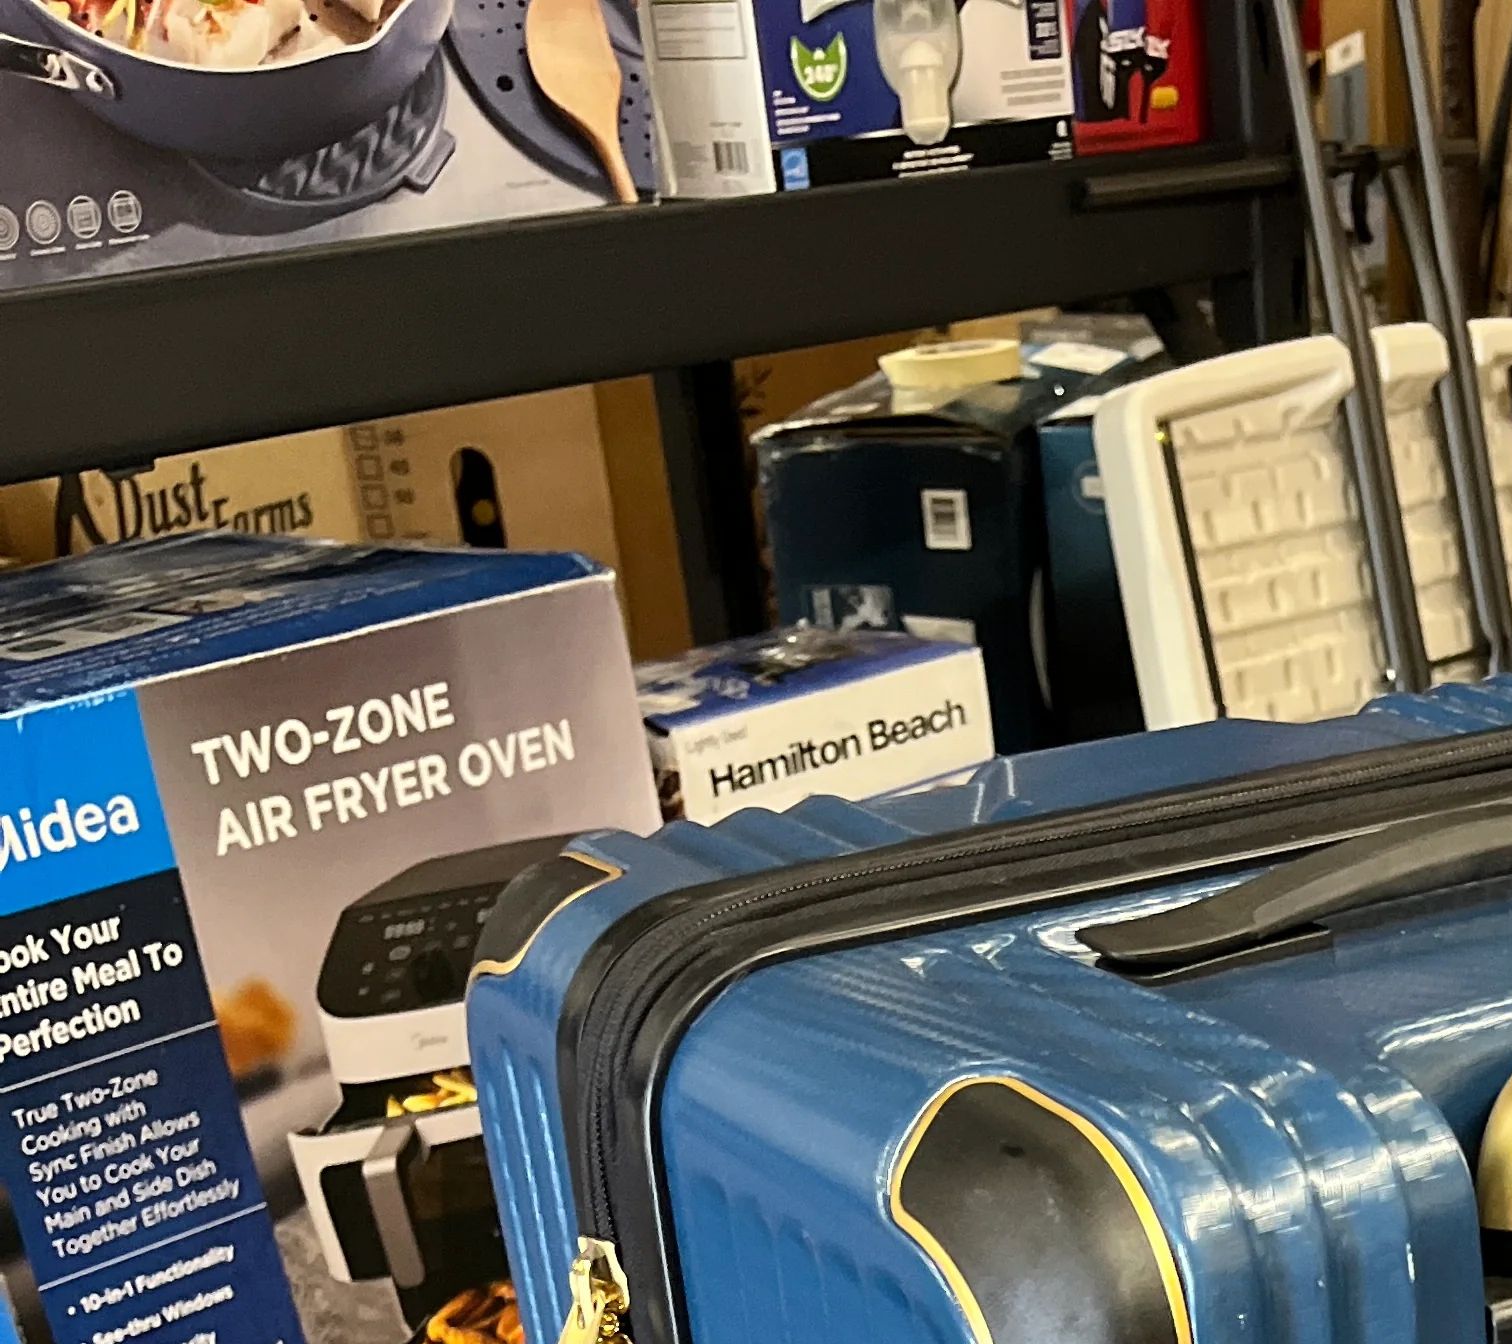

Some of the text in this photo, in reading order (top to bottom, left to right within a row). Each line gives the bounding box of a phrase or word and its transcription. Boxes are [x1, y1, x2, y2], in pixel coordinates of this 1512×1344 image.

[114, 461, 209, 541] Dust
[190, 681, 456, 786] TWO-ZONE
[709, 731, 862, 798] Hamilton
[867, 699, 967, 752] Beach
[216, 718, 576, 857] AIR FRYER OVEN
[0, 916, 120, 974] ook Your
[0, 942, 183, 1019] ntire Meal To
[0, 999, 141, 1063] Perfection
[11, 1069, 159, 1129] True Two-Zone
[21, 1099, 147, 1156] Cooking with
[28, 1110, 201, 1183] Sync Finish Allows
[36, 1138, 200, 1208] You to Cook Your
[44, 1157, 217, 1234] Main and Side Dish
[52, 1178, 240, 1259] Together Effortlessly
[135, 1244, 235, 1296] Functionality
